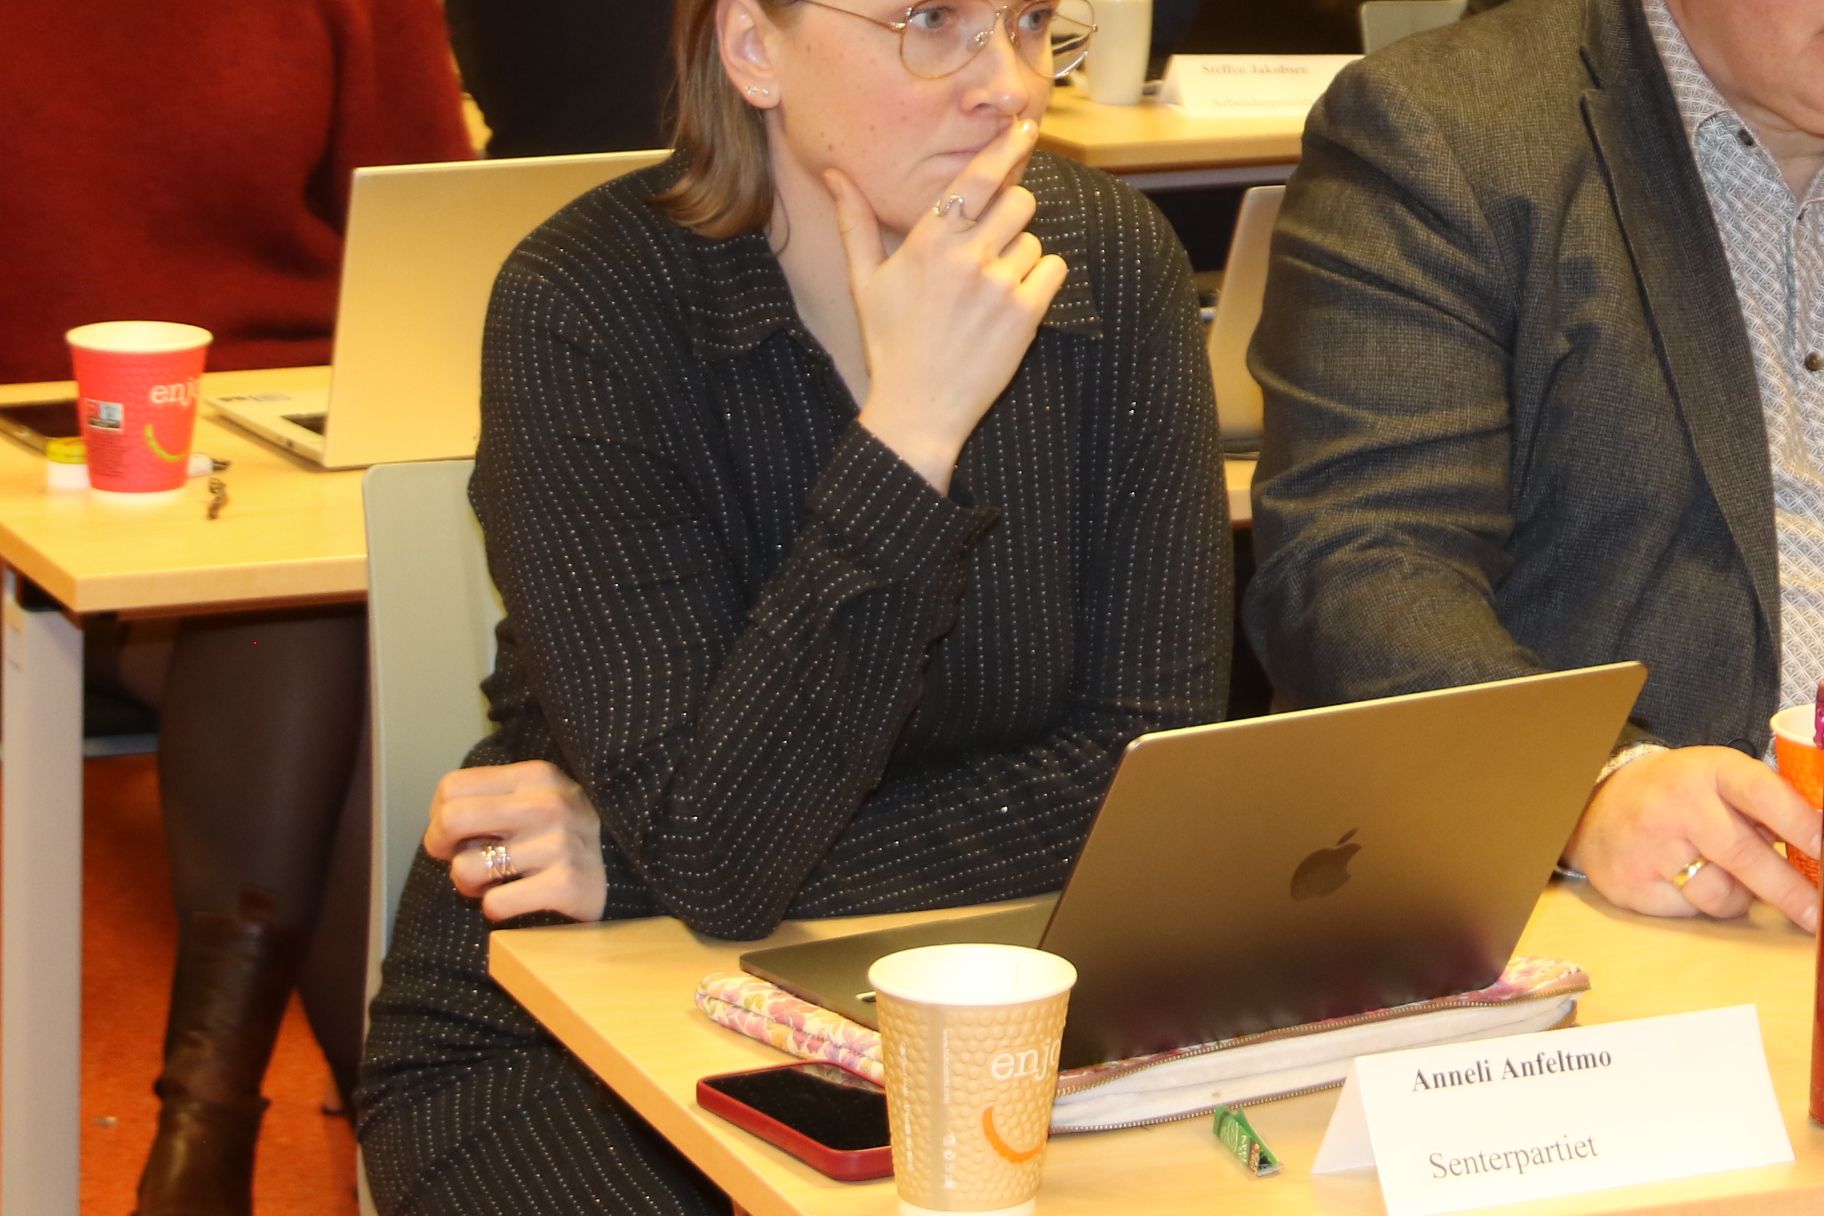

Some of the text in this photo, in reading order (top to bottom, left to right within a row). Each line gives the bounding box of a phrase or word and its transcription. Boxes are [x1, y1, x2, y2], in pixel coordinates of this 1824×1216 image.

[1411, 1046, 1613, 1093] Anneli Anfeltmo
[1428, 1134, 1599, 1179] Senterpartiet
